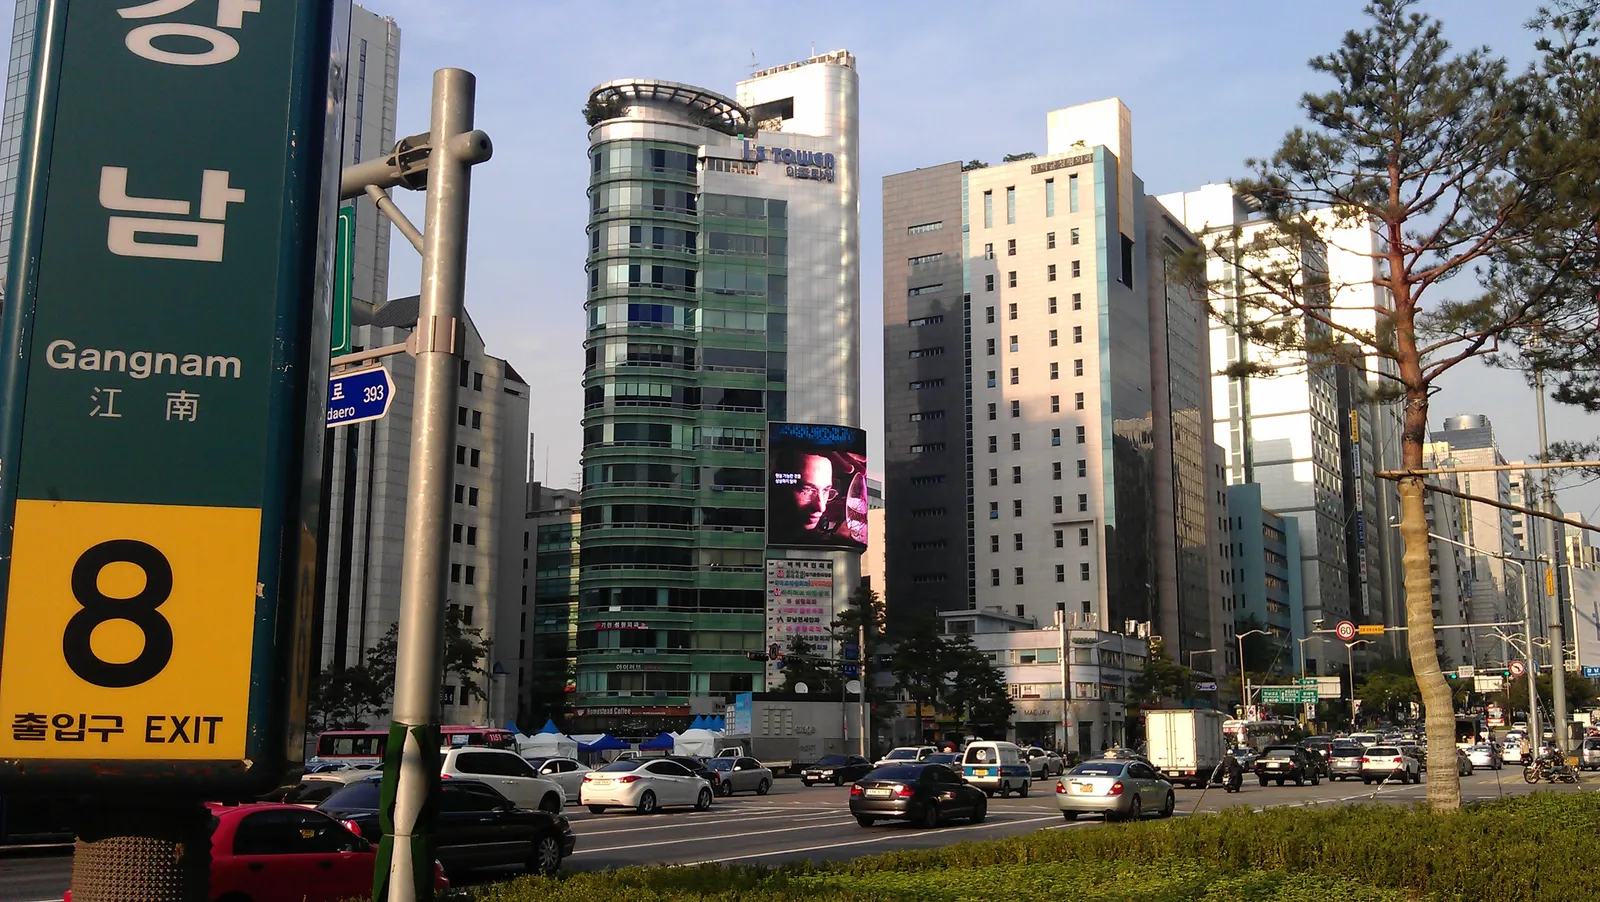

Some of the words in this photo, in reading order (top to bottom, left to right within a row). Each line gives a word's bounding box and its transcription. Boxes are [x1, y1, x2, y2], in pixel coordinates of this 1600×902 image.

[771, 147, 836, 169] TOWER
[45, 339, 242, 380] Gangnam
[363, 384, 385, 403] 393
[62, 539, 174, 688] 8
[1340, 626, 1352, 635] 60
[614, 707, 632, 715] Coffee
[11, 712, 125, 744] 출입구
[145, 715, 224, 744] EXIT
